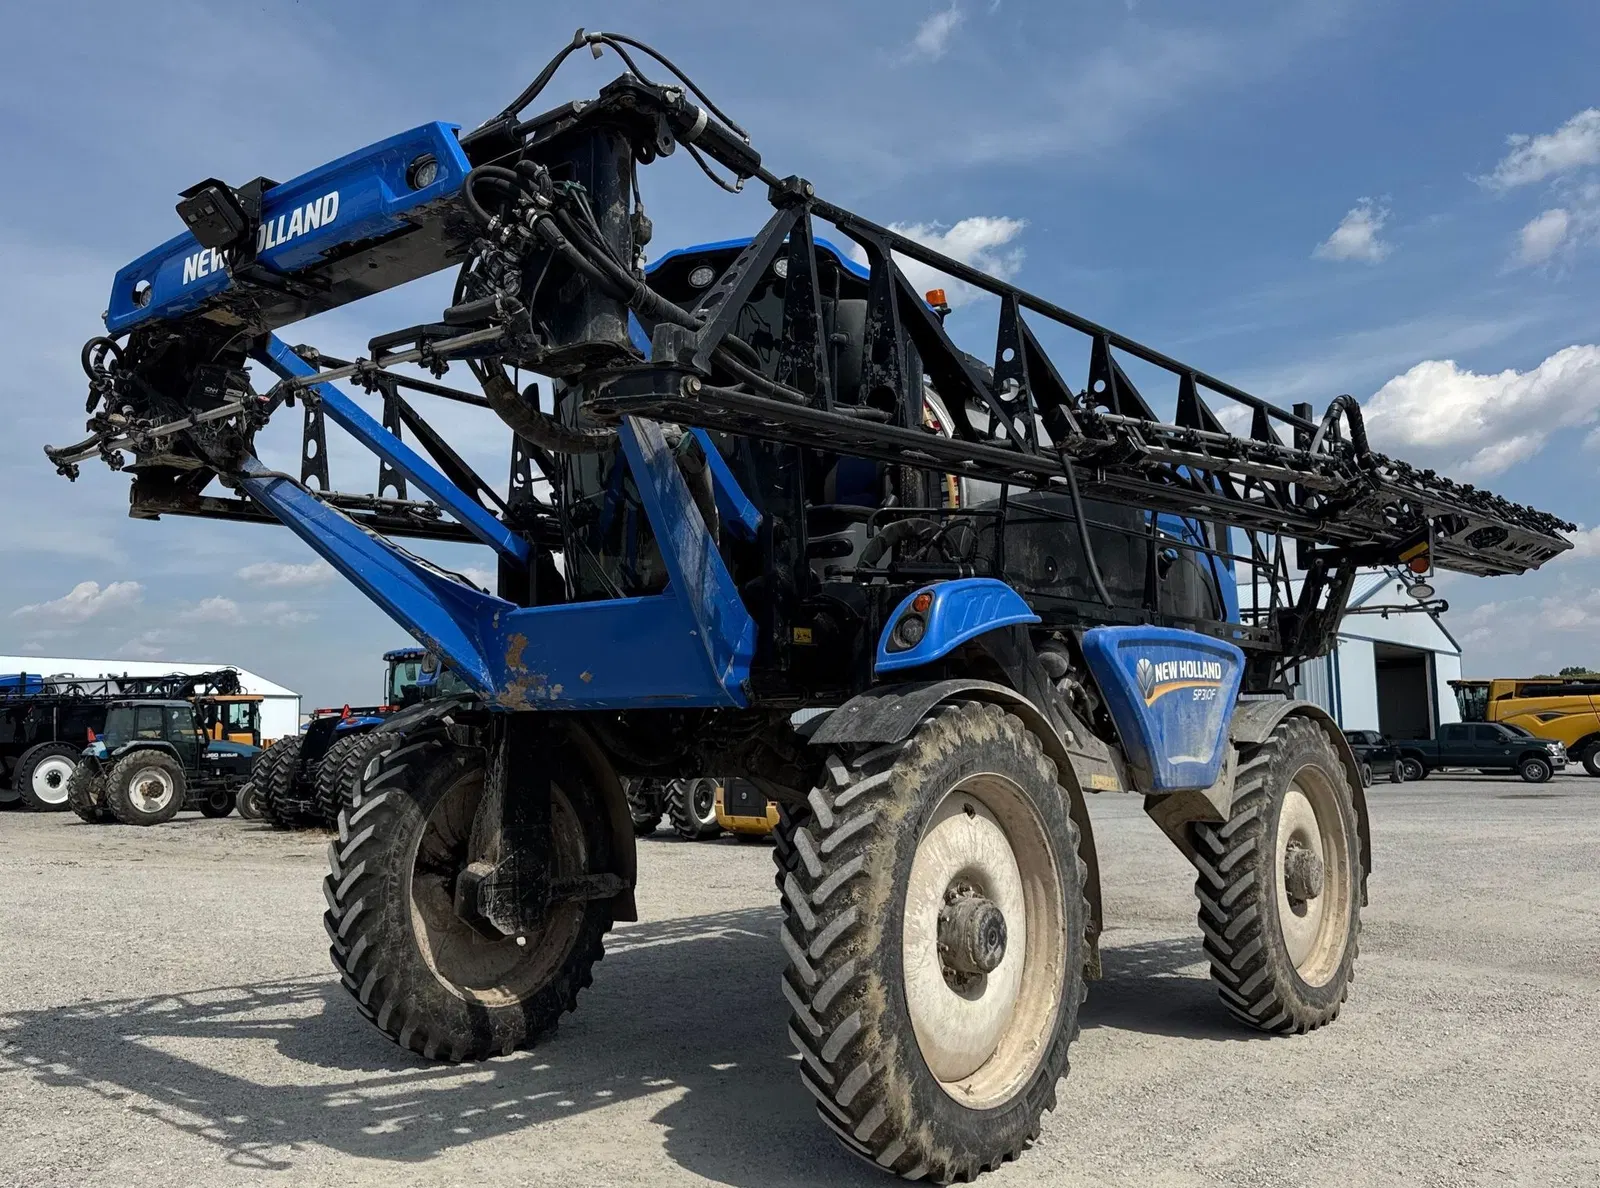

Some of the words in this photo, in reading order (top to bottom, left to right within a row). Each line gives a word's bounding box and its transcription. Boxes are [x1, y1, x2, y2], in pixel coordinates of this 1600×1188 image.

[256, 190, 340, 256] OLLAND
[1155, 661, 1178, 682] NEW
[1180, 661, 1221, 679] HOLLAND
